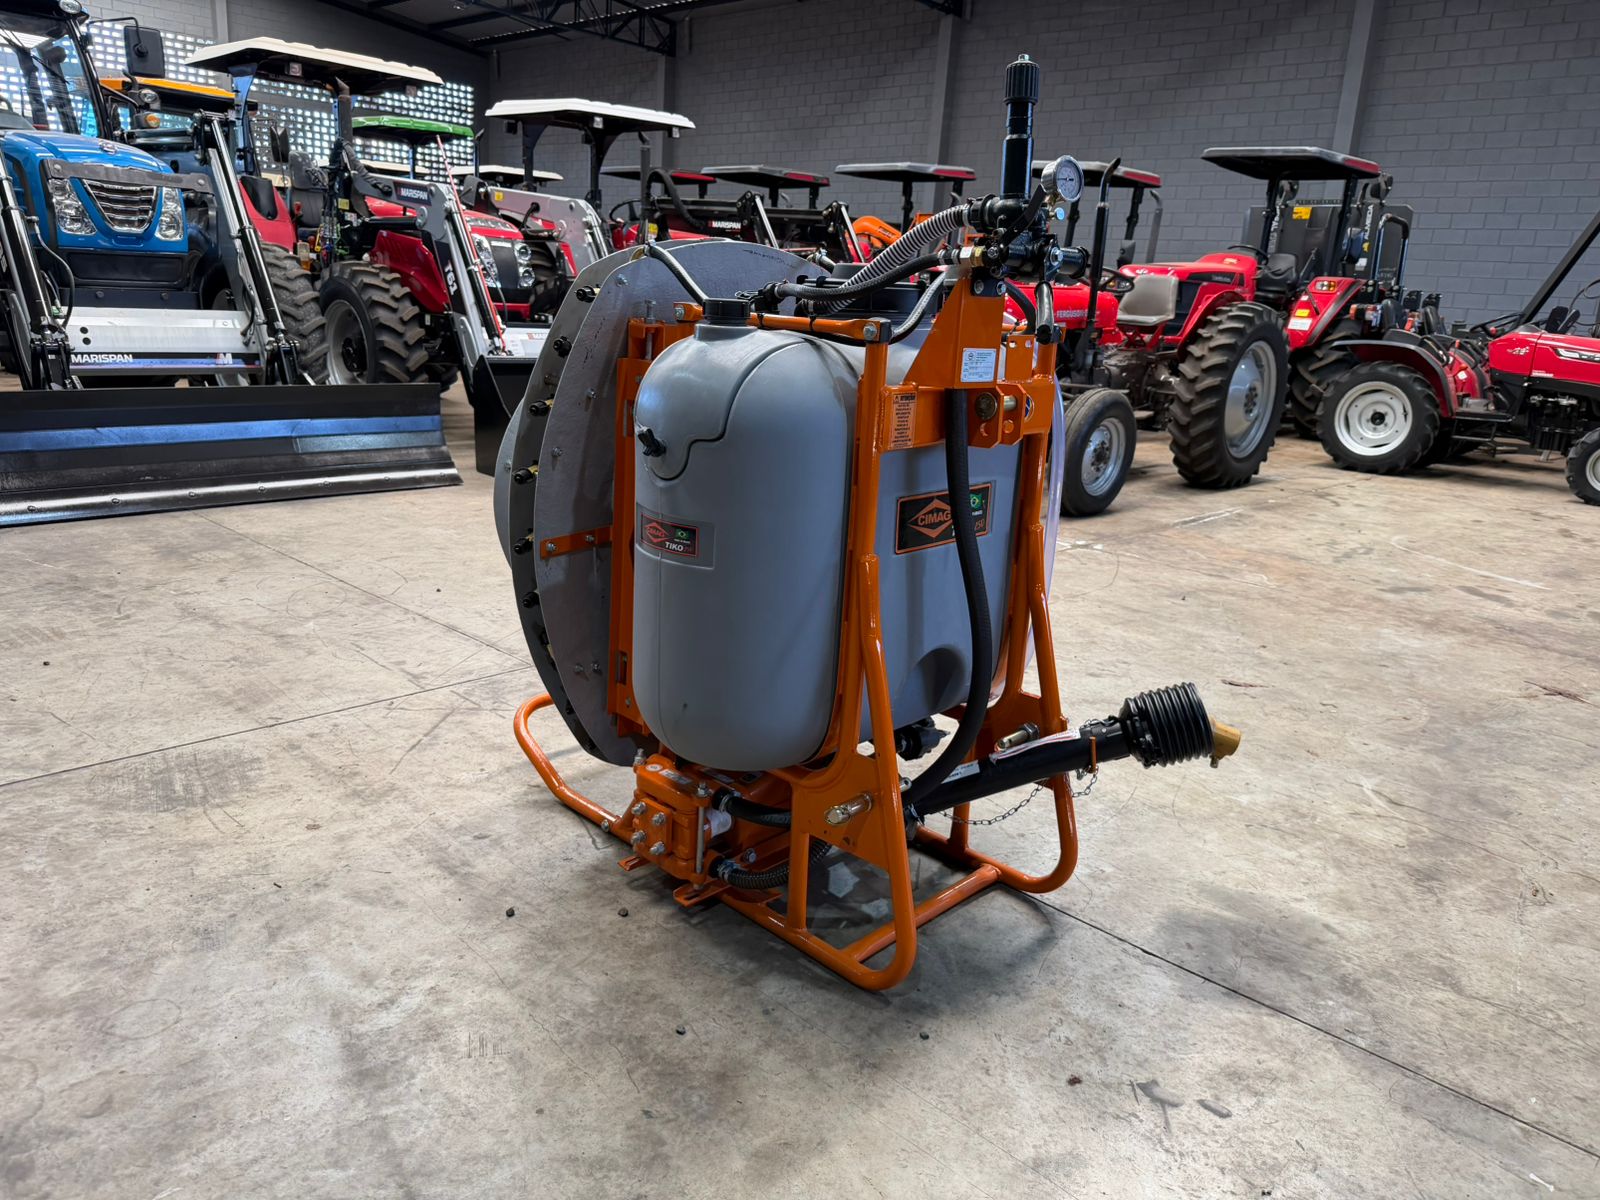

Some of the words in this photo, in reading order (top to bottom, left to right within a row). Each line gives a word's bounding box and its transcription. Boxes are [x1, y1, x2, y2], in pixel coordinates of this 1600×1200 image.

[401, 187, 429, 200] MARISPAN
[712, 220, 741, 229] MARISPAN
[445, 260, 458, 296] T61
[71, 354, 133, 363] MARISPAN
[665, 541, 684, 552] TIKO
